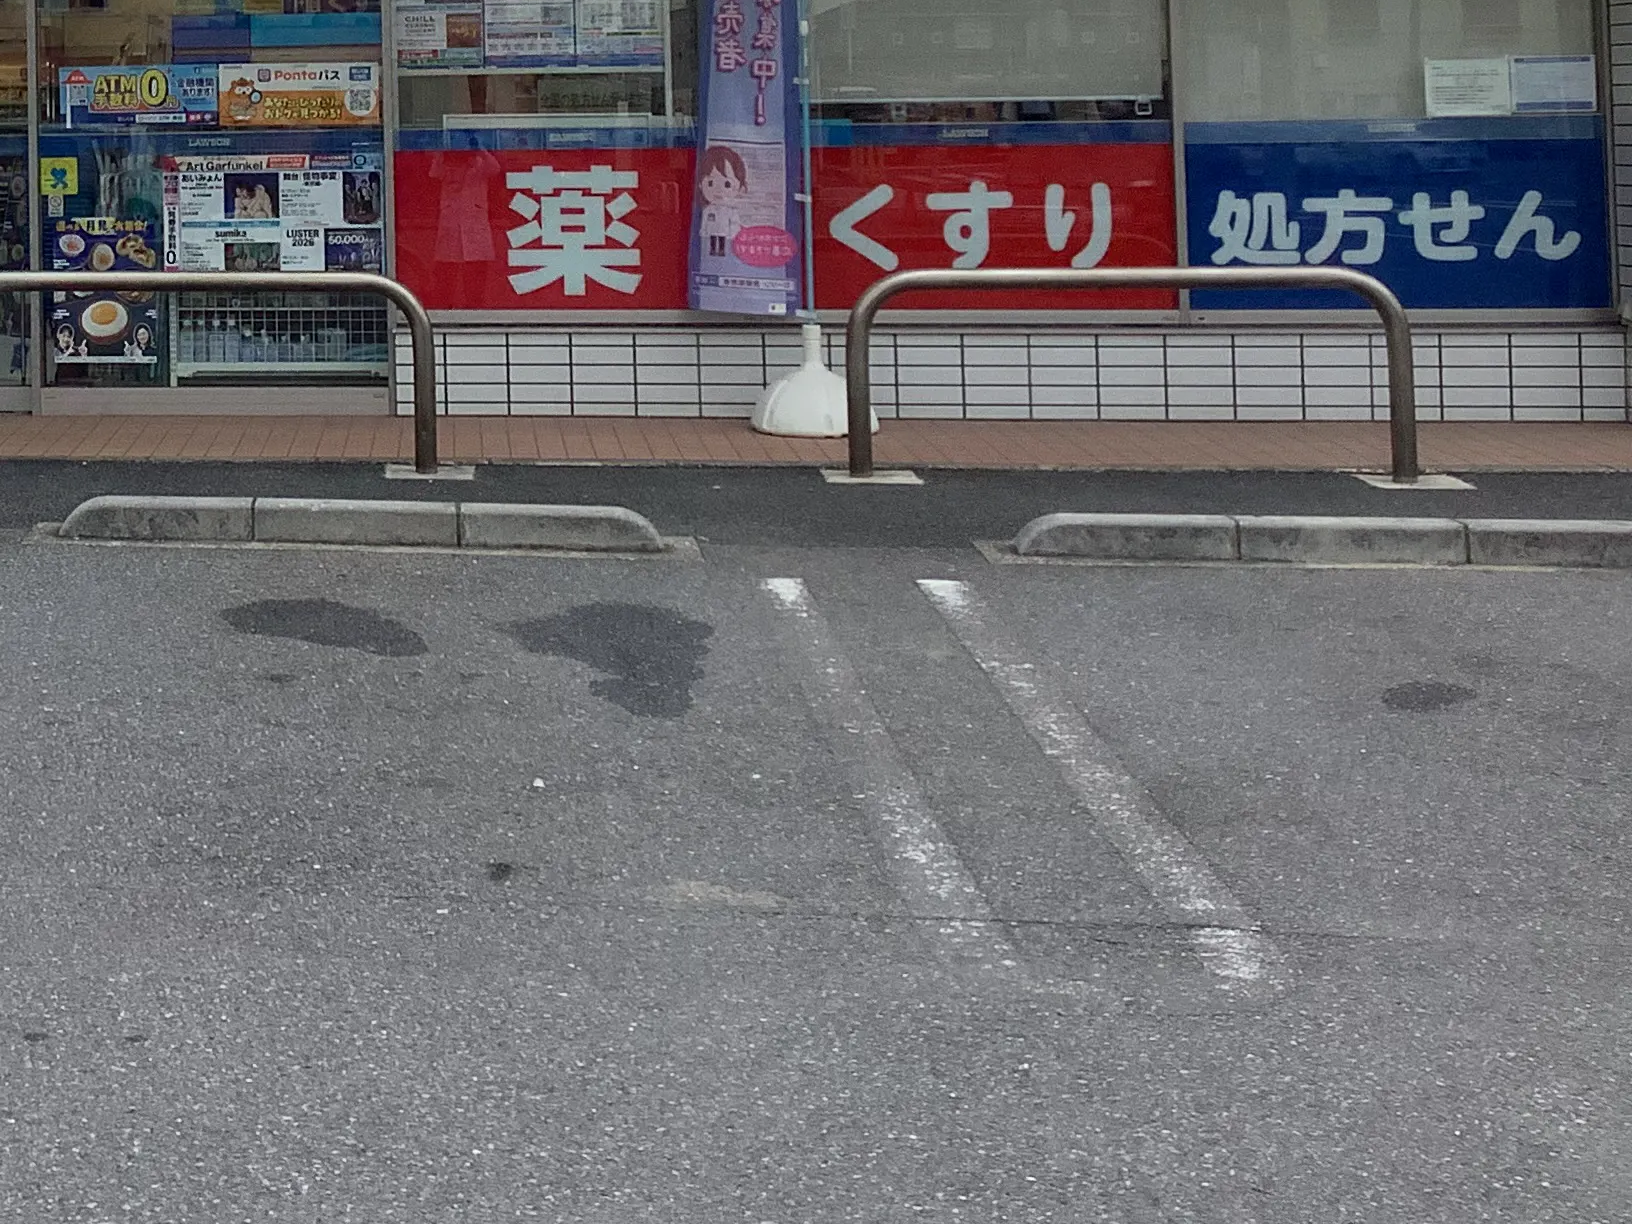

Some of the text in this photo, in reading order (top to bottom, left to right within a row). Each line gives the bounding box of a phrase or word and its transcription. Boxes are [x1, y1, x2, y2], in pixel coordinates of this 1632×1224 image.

[95, 75, 136, 93] ATM
[186, 161, 204, 172] Art
[206, 160, 263, 171] Garfunkel
[287, 229, 320, 238] LUSTER
[505, 164, 643, 297] 薬
[829, 181, 1112, 271] くすり
[1209, 187, 1581, 268] 処方せん
